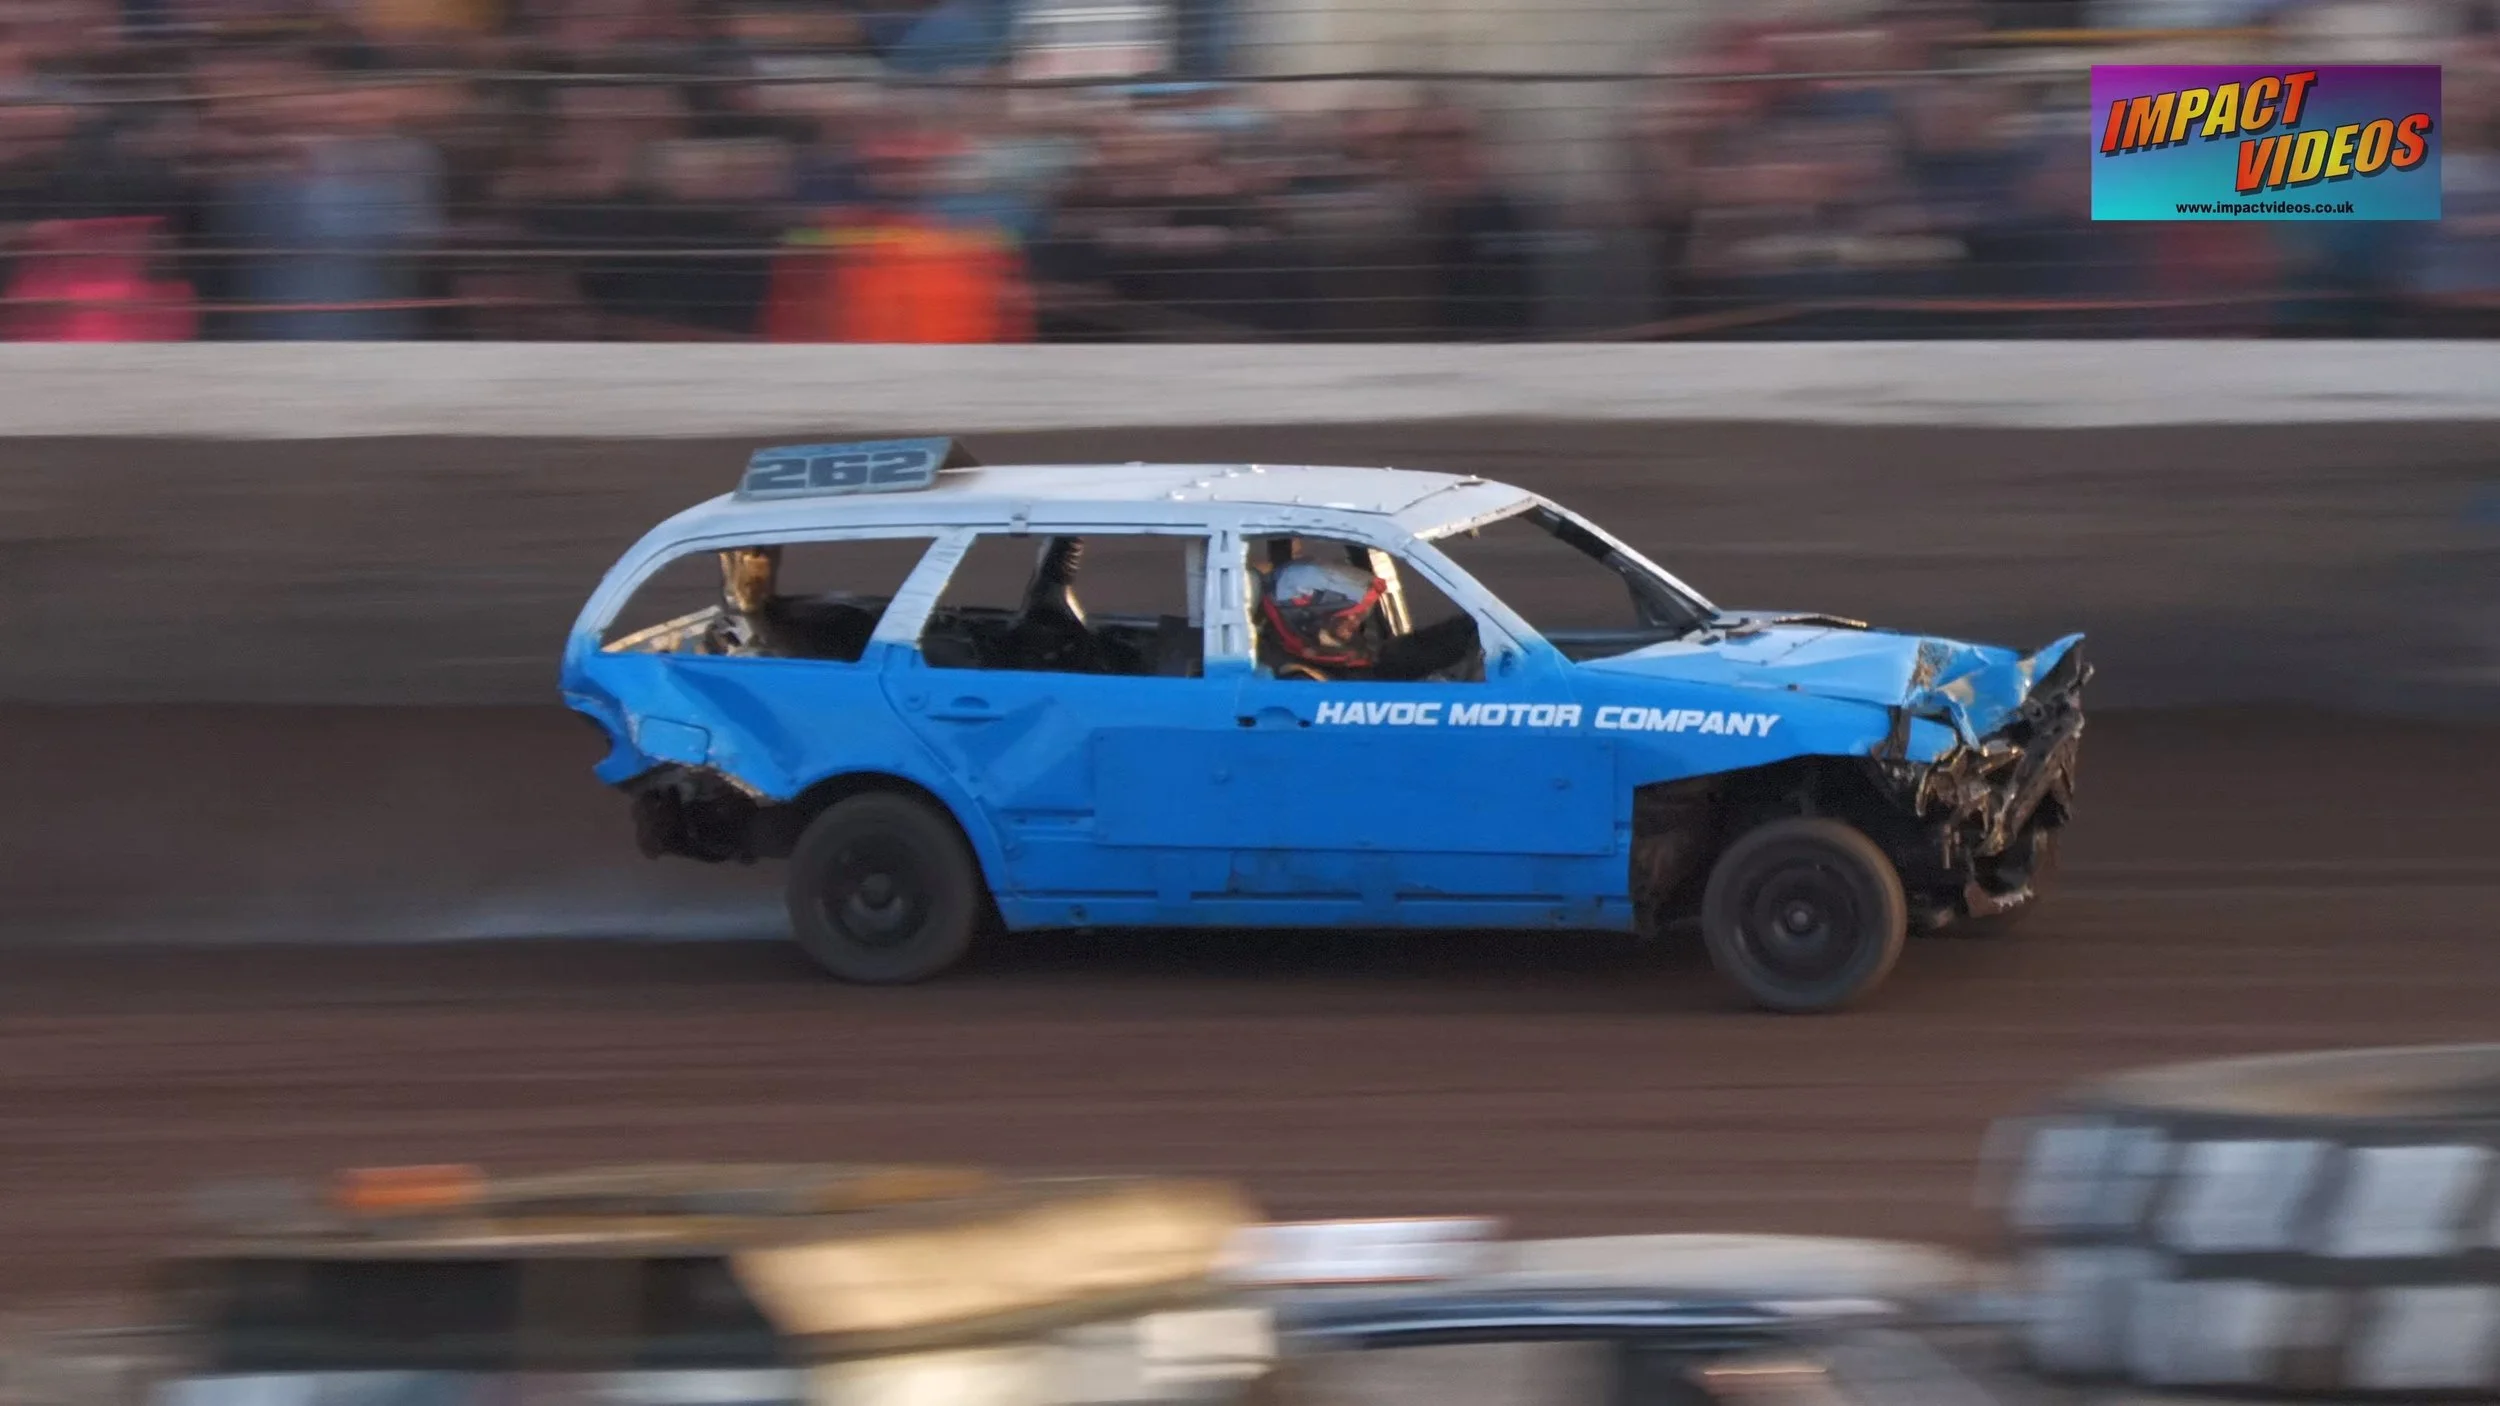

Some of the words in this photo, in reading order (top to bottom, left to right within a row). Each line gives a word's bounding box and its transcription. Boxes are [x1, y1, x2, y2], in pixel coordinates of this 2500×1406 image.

[747, 450, 928, 491] 262
[1315, 701, 1441, 726] HAVOC
[1448, 702, 1582, 729] MOTOR
[1594, 706, 1780, 738] COMPANY
